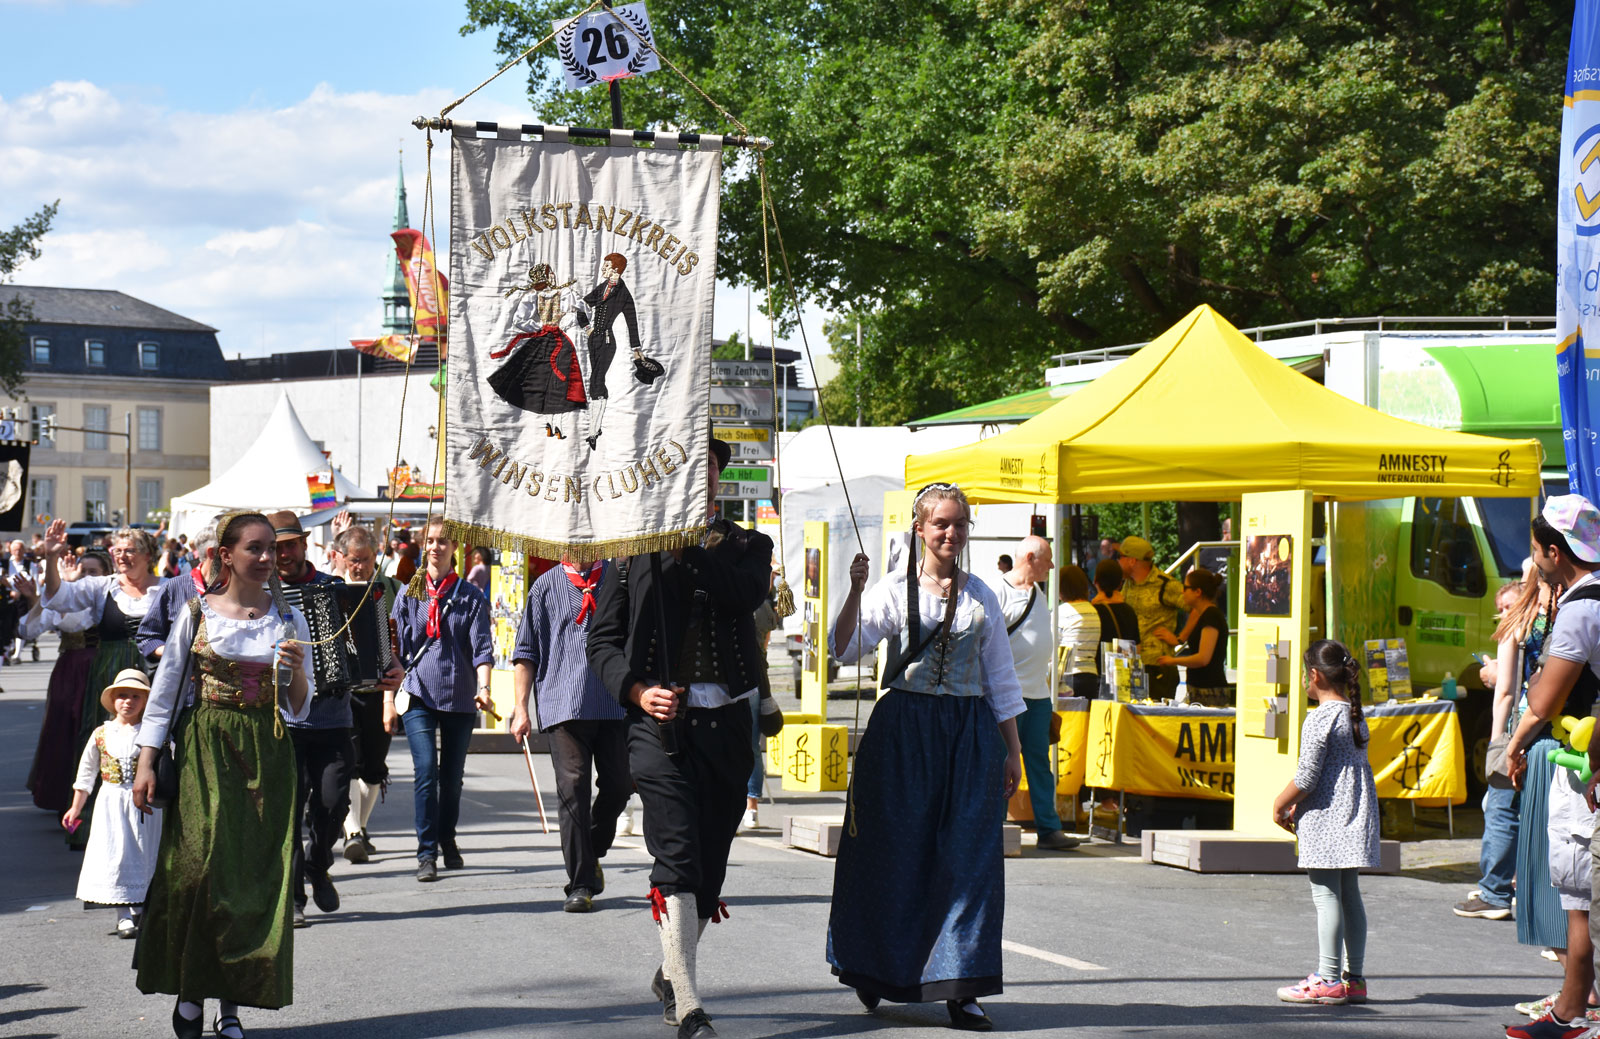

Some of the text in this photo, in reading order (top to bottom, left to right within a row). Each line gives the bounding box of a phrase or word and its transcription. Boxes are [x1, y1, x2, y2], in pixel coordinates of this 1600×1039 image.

[581, 23, 630, 65] 26
[471, 203, 700, 276] VOLKSTANZKREIS
[735, 366, 769, 376] Zentrum
[744, 407, 760, 416] frei
[736, 431, 765, 440] Steintor
[743, 447, 759, 455] frei
[1000, 457, 1024, 474] AMNESTY
[1379, 454, 1447, 472] AMNESTY
[469, 437, 688, 503] WINSEN (LUHE)
[1377, 474, 1445, 484] INTERNATIONAL
[742, 486, 758, 495] frei
